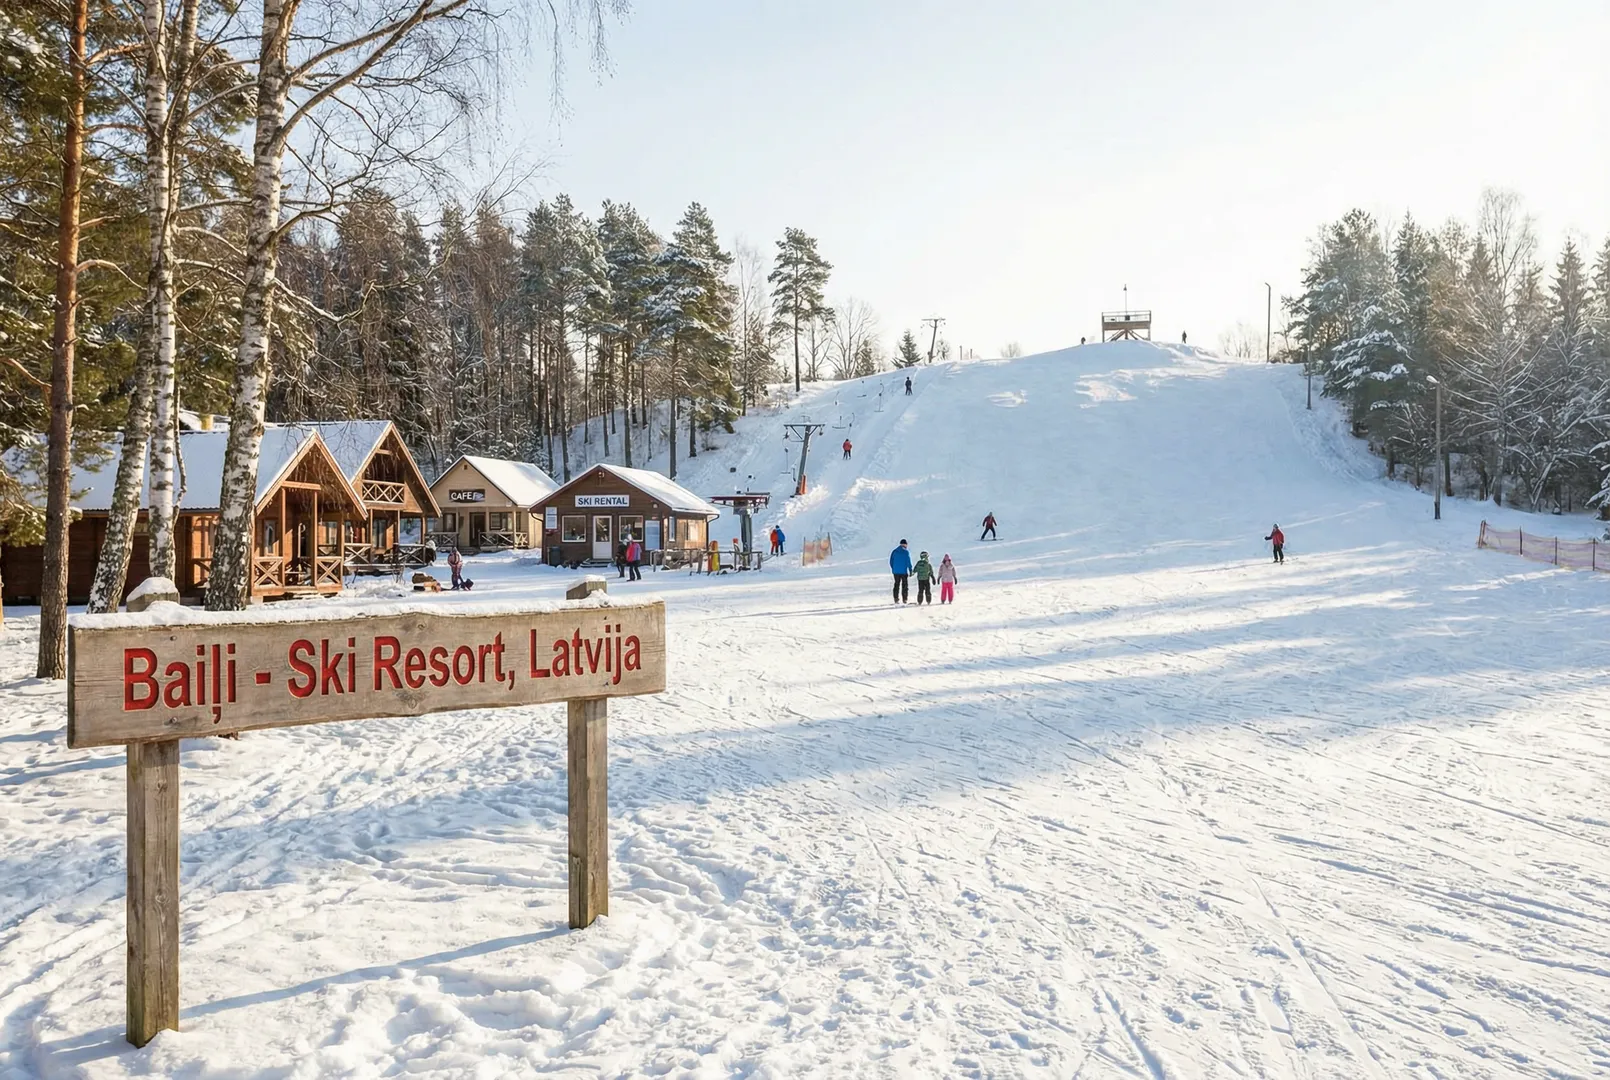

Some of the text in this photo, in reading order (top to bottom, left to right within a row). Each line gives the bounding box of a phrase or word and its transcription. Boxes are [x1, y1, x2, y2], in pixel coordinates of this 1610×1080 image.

[577, 497, 628, 506] SKI RENTAL
[123, 643, 236, 724] Baiļi
[286, 636, 356, 699] Ski
[373, 632, 514, 691] Resort,
[529, 623, 642, 686] Latvija
